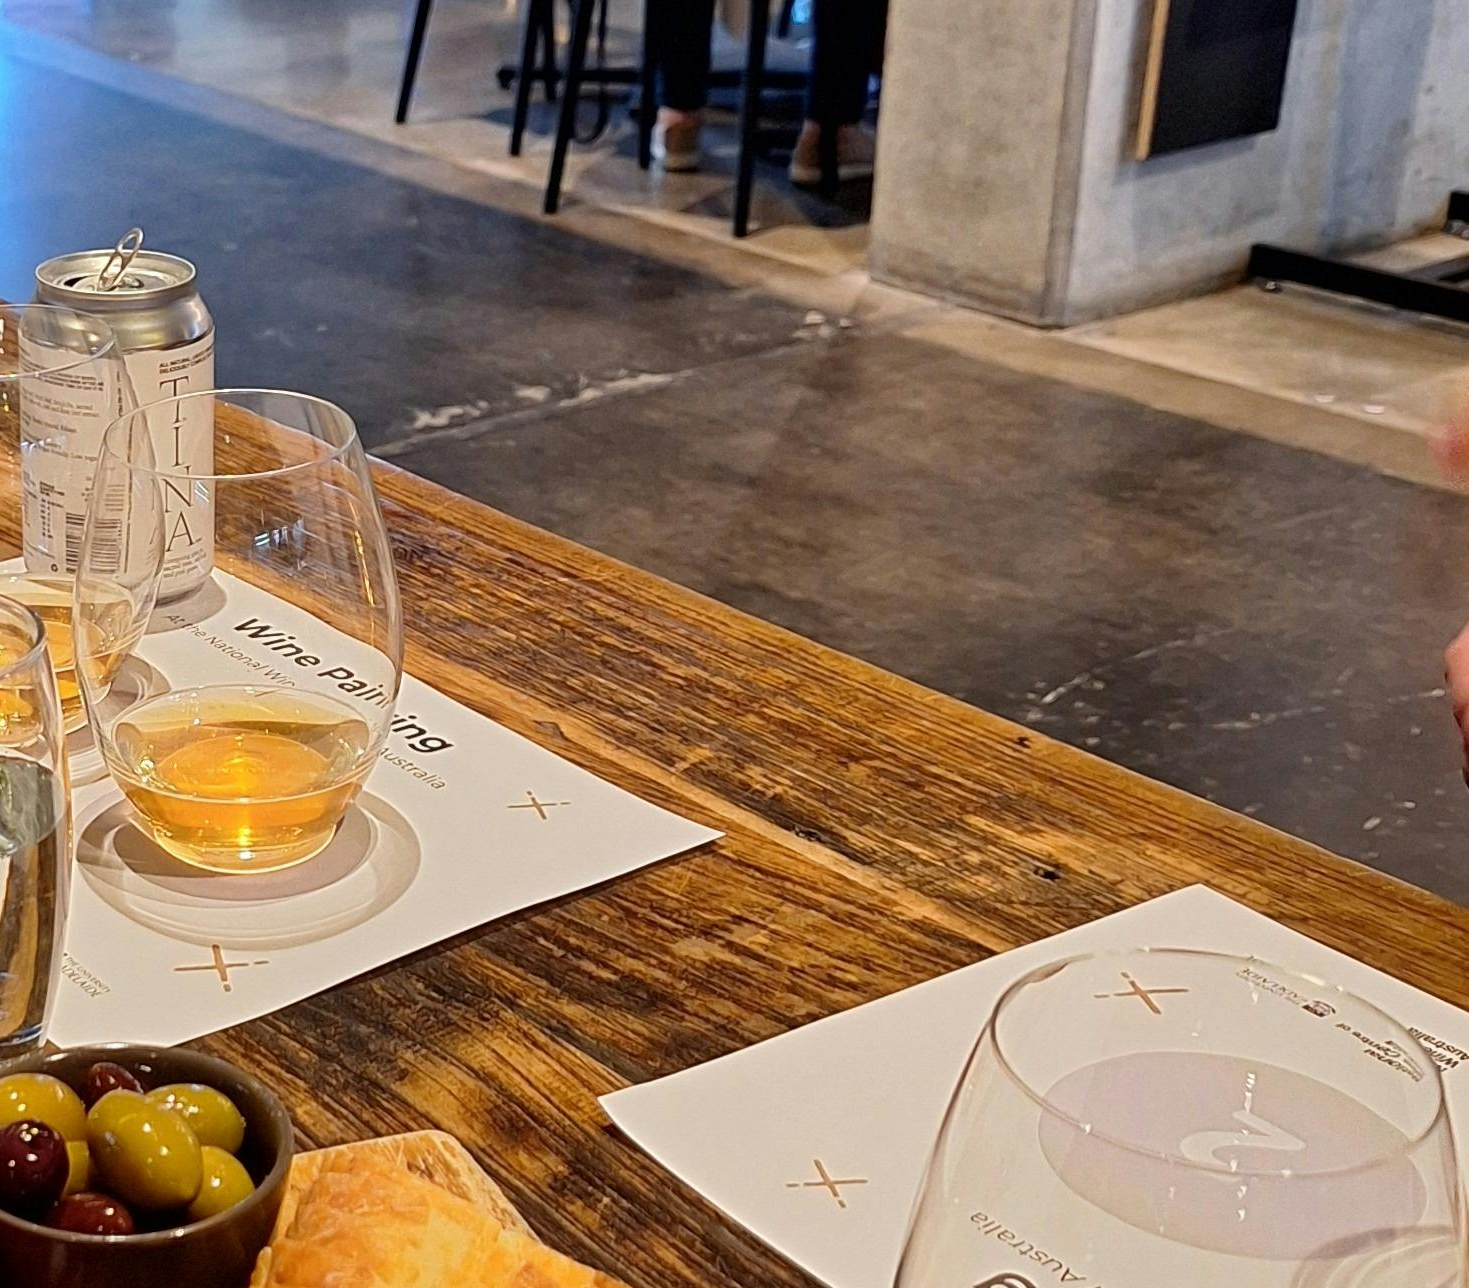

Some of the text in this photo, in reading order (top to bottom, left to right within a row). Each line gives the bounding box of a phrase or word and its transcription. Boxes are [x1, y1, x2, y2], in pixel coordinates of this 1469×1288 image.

[205, 636, 266, 673] National
[263, 667, 298, 687] Win
[234, 617, 321, 668] Wine
[970, 1212, 1086, 1282] Australia
